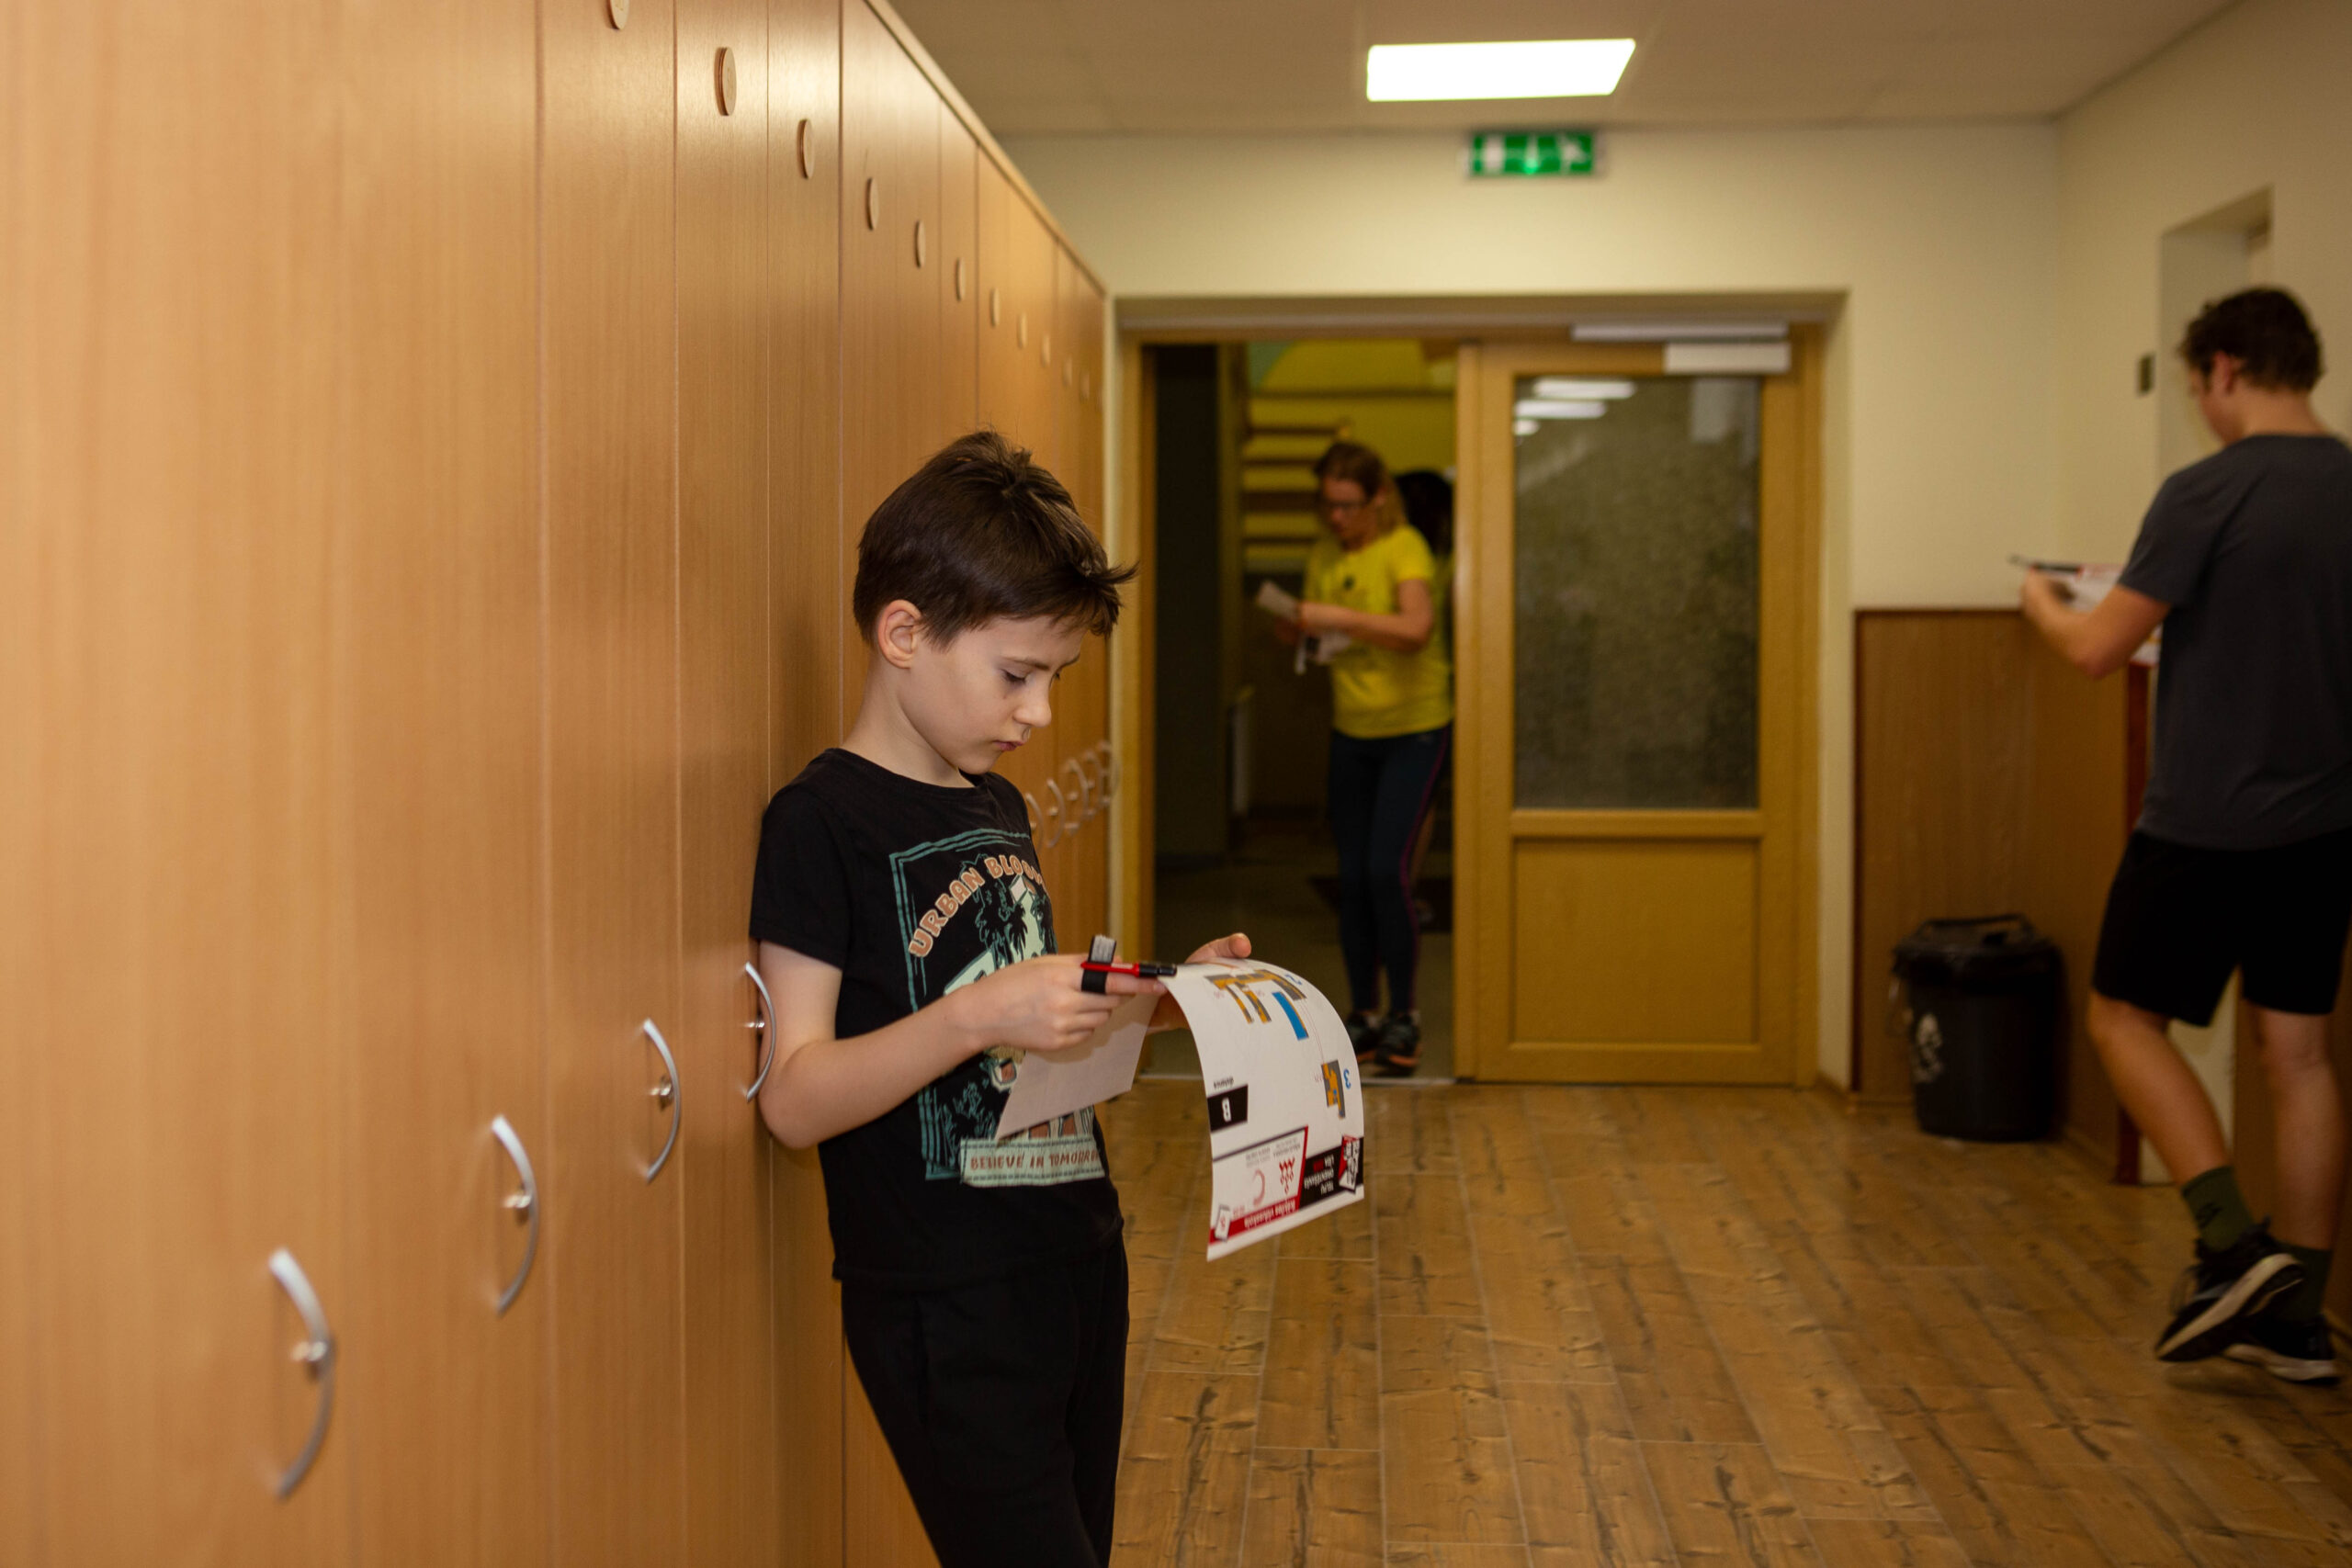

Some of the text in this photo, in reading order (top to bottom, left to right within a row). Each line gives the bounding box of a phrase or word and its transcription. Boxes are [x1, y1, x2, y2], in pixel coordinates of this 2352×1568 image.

[909, 867, 985, 957] URBAN
[1343, 1068, 1351, 1089] 3
[1222, 1097, 1232, 1122] B
[970, 1153, 1025, 1170] BELIEVE
[1030, 1155, 1045, 1169] IN
